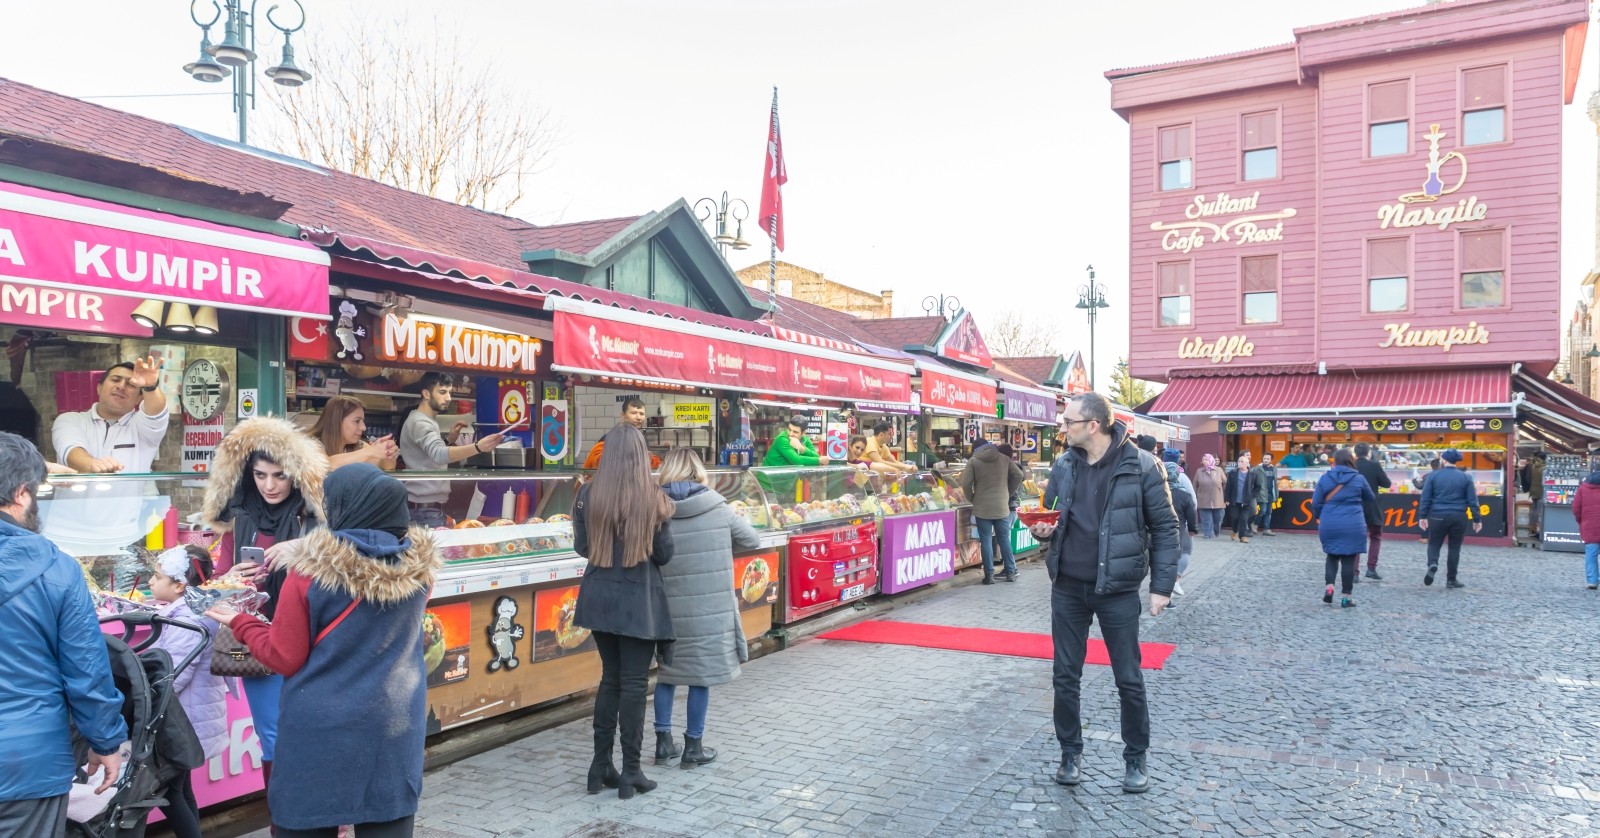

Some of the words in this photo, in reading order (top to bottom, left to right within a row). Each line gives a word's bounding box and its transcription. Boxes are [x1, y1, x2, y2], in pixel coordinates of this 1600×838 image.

[1185, 191, 1260, 219] Sultani
[1377, 195, 1487, 231] Nargile
[1161, 228, 1204, 253] Cafe
[1234, 221, 1283, 245] Rest.
[74, 240, 264, 298] KUMPİR
[383, 312, 437, 361] Mr.
[442, 325, 542, 372] Kumpir
[1178, 335, 1255, 363] Waffle
[1378, 321, 1490, 352] Kumpir
[675, 404, 691, 412] KREDİ
[931, 380, 946, 400] Ali
[946, 383, 966, 405] Baba
[904, 519, 946, 550] MAYA
[896, 549, 952, 586] KUMPİR
